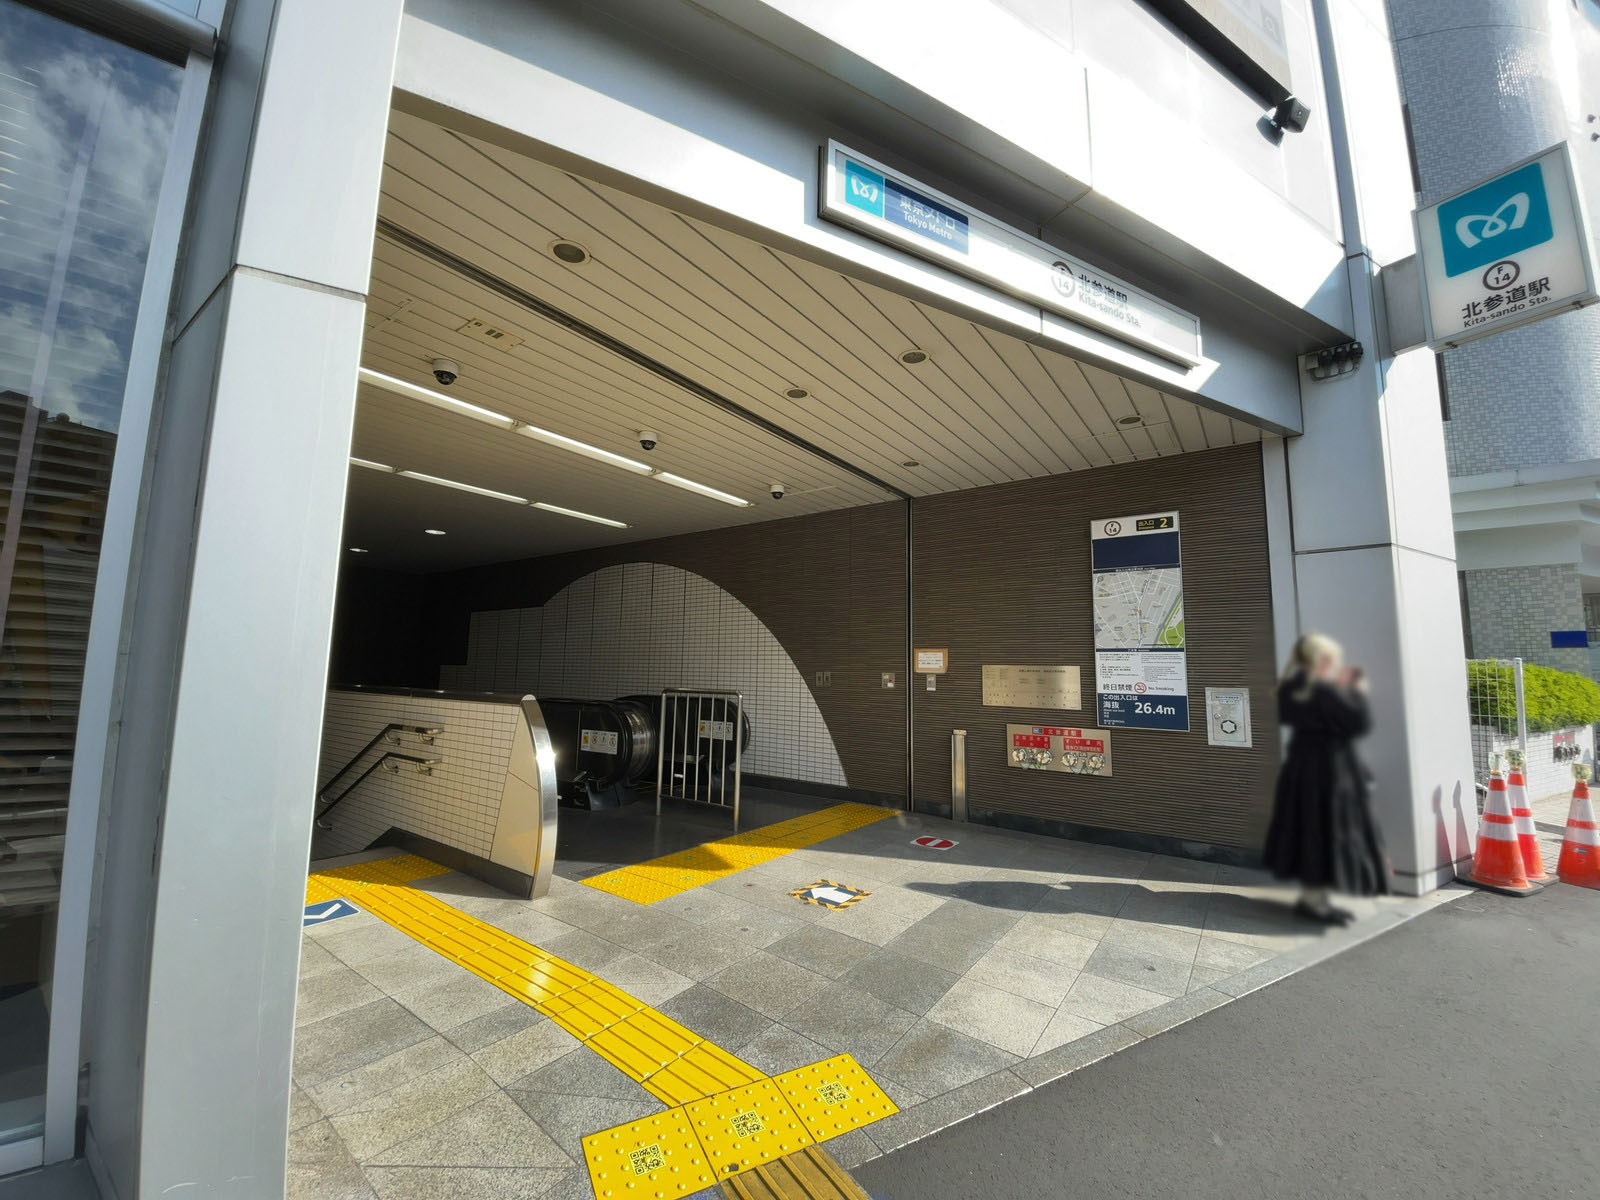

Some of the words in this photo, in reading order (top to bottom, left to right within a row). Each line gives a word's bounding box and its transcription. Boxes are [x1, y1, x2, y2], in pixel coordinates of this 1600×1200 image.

[903, 210, 928, 228] Tokyo
[928, 222, 953, 240] Metro
[1497, 266, 1504, 275] F
[1494, 273, 1511, 285] 14
[1461, 276, 1551, 319] 北参道駅
[1078, 291, 1125, 320] Kita-sando
[1125, 313, 1142, 328] Sta.
[1463, 303, 1526, 328] Kita-sando
[1528, 295, 1552, 307] Sta.
[1160, 518, 1168, 528] 2
[1103, 683, 1133, 692] 終日禁煙
[1103, 701, 1120, 709] 海抜
[1134, 702, 1176, 715] 26.4m
